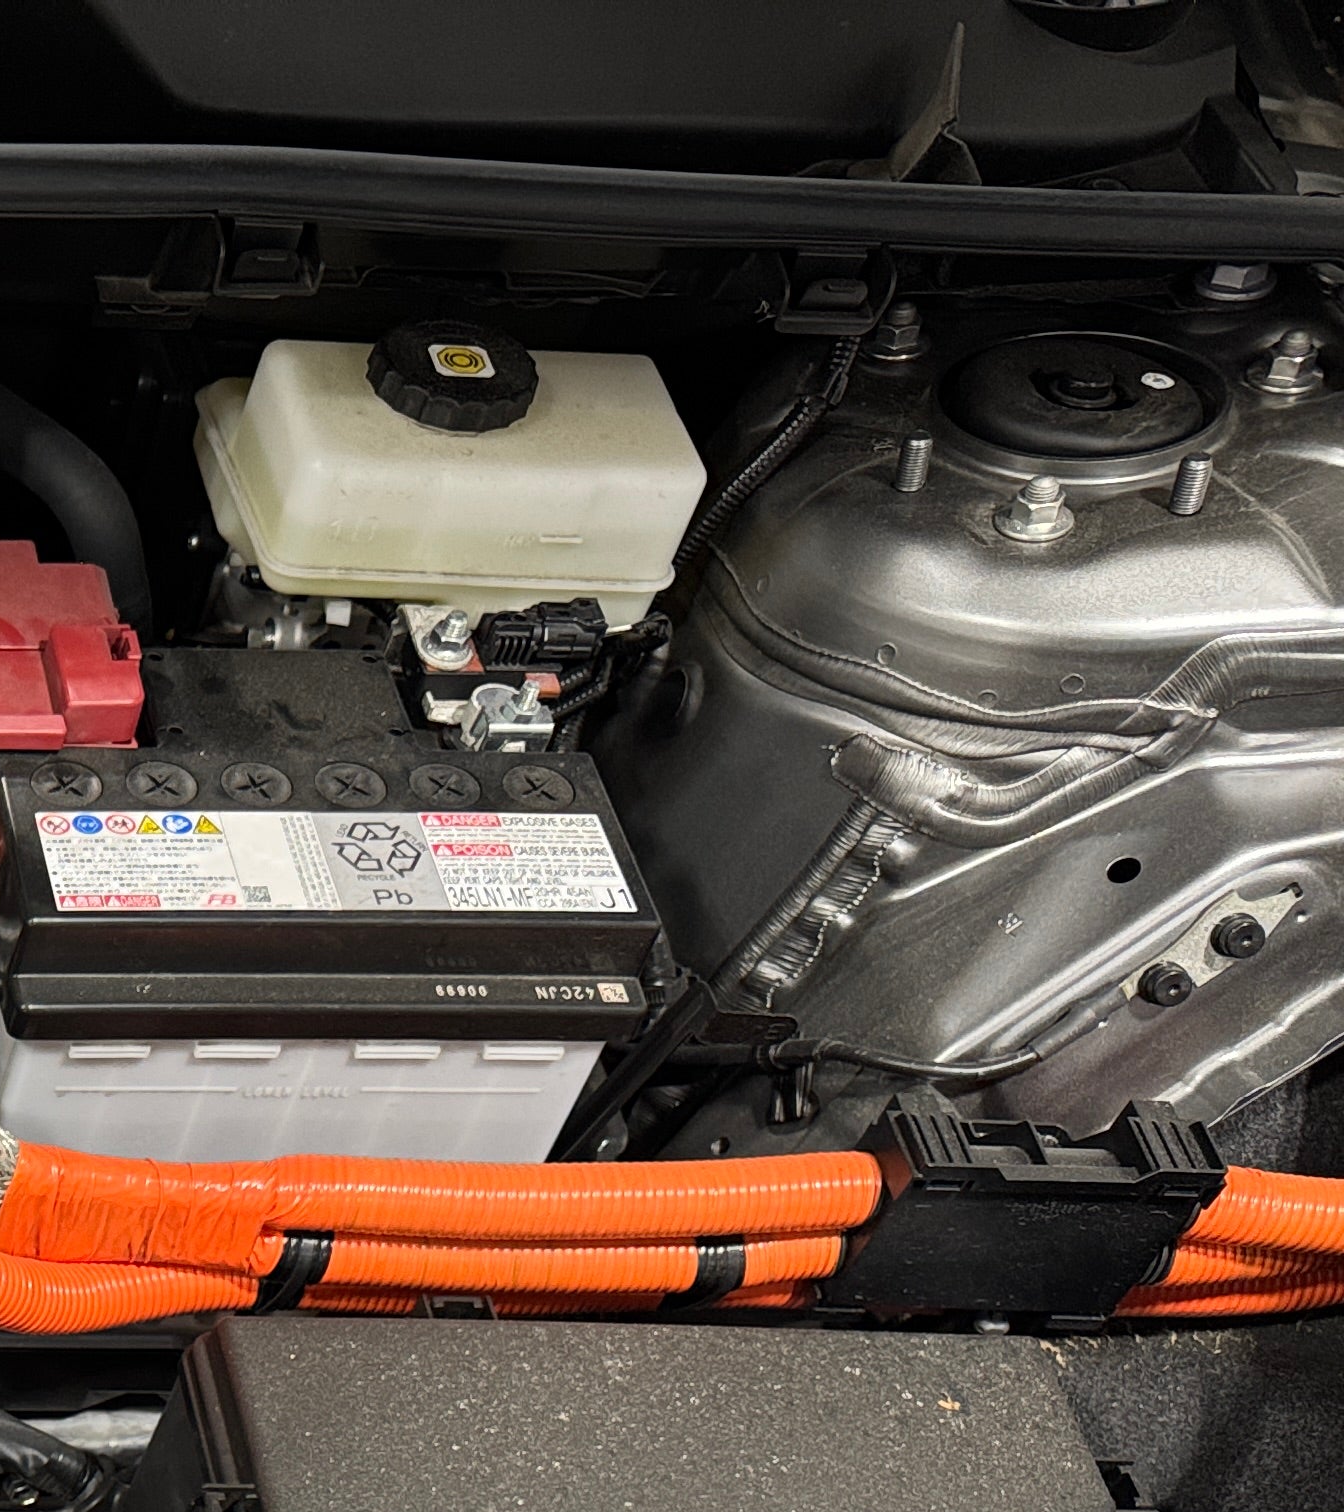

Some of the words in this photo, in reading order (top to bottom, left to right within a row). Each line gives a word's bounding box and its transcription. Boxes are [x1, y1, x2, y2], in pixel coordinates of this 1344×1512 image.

[441, 815, 498, 826] DANGER
[452, 845, 511, 856] POISON
[208, 893, 237, 905] FB
[373, 889, 413, 905] Pb
[448, 886, 533, 907] 345LN1-MF
[600, 887, 633, 909] J1
[534, 985, 595, 1000] 42CJN
